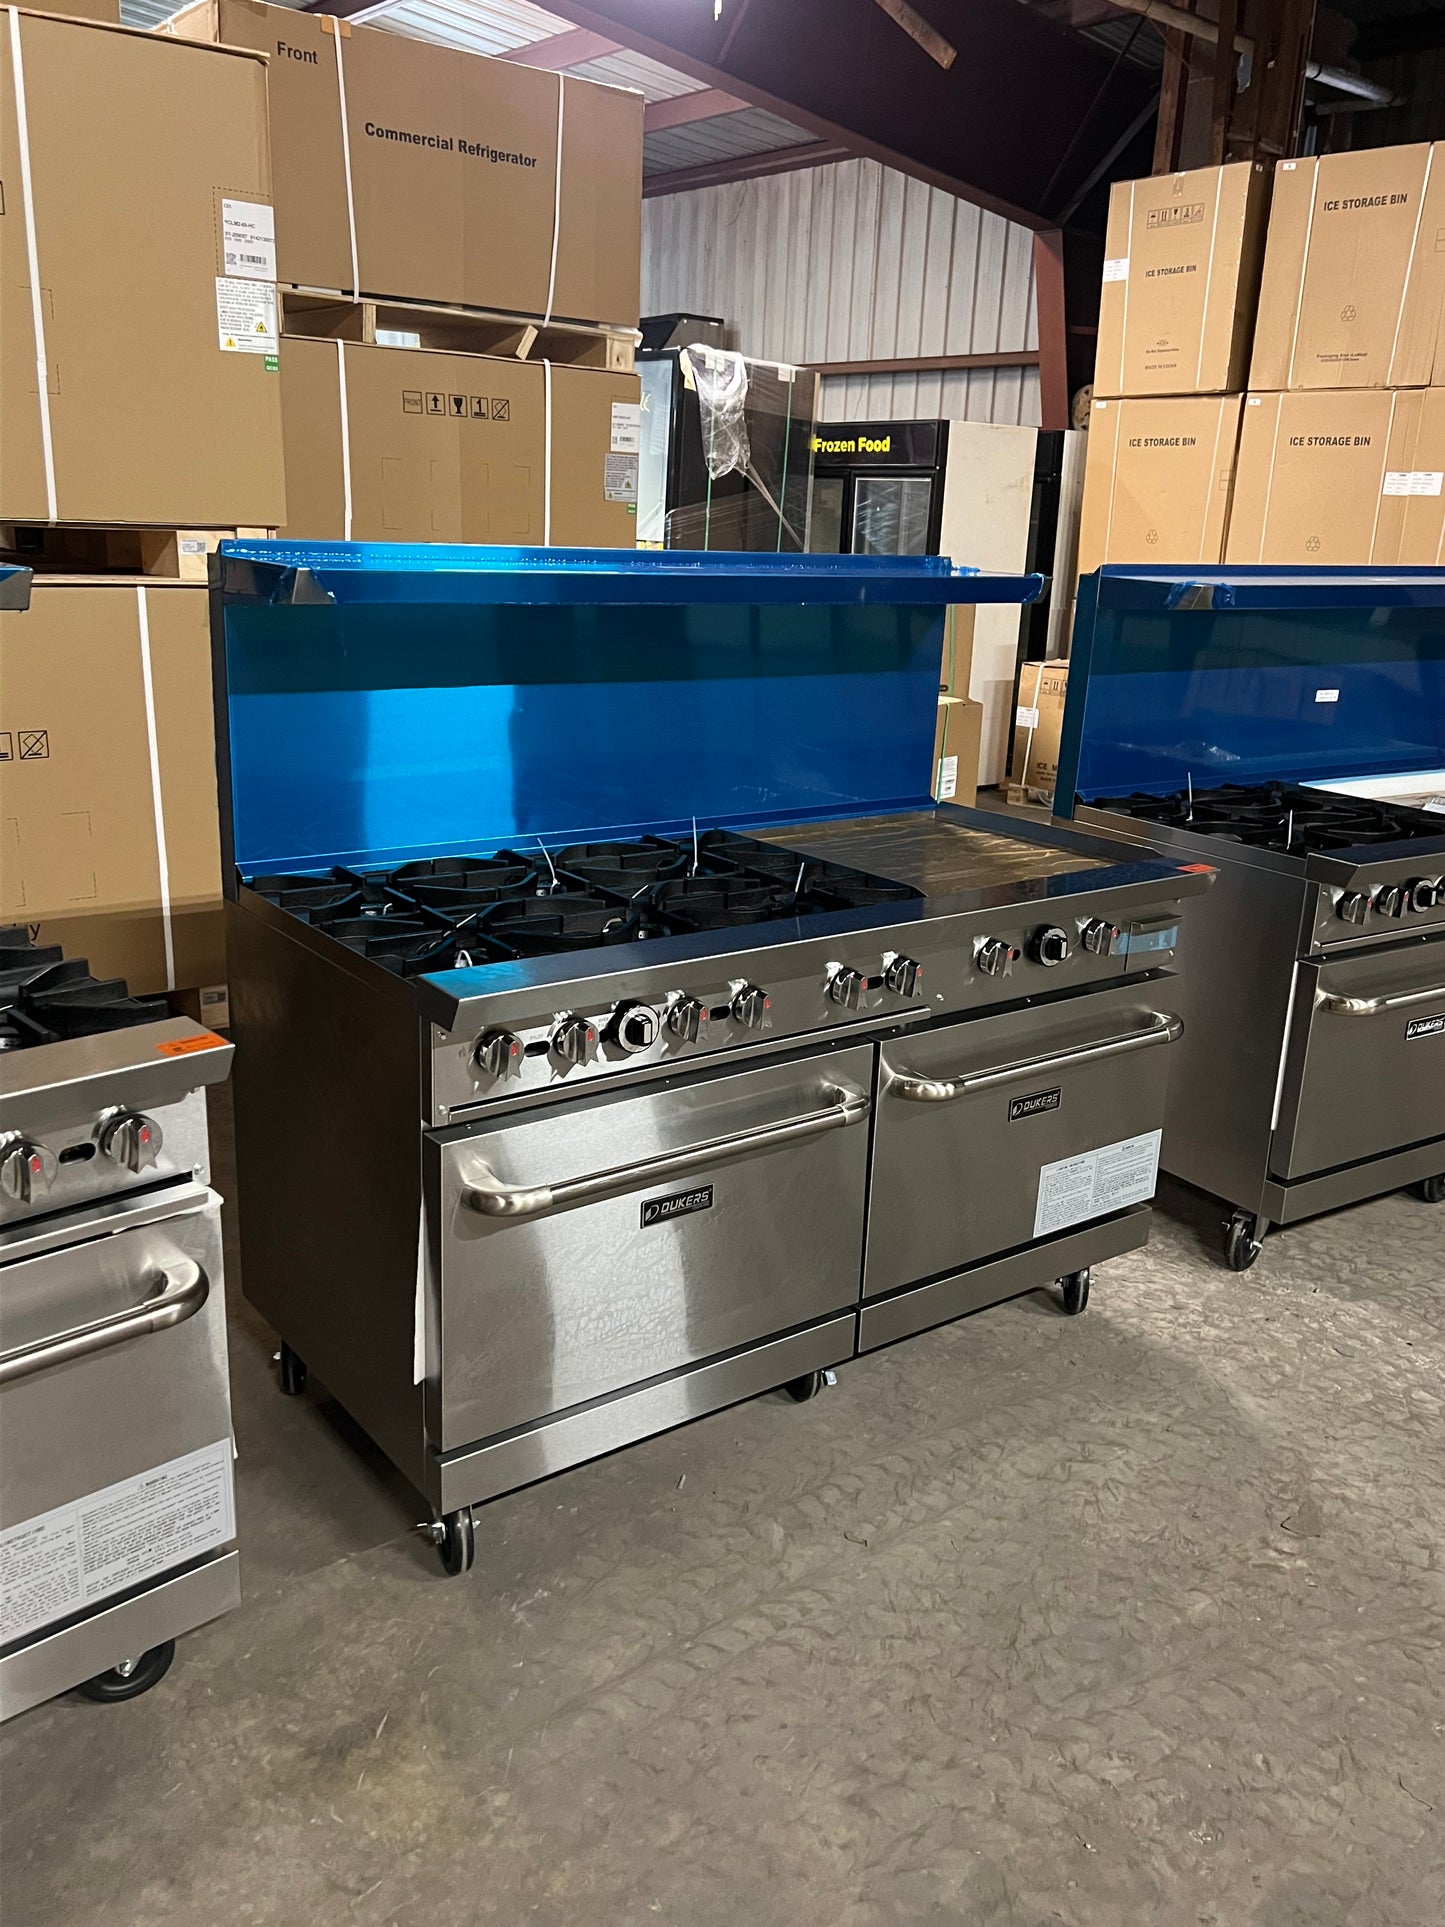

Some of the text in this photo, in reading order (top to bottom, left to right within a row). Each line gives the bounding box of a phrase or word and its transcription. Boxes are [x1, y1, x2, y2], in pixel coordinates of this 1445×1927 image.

[277, 40, 318, 64] Front
[365, 122, 537, 168] Commercial Refrigerator
[1323, 193, 1408, 211] ICE STORAGE BIN
[1145, 264, 1197, 277] ICE STORAGE BIN
[814, 435, 890, 452] Frozen Food
[1129, 437, 1196, 447] ICE STORAGE BIN
[1289, 436, 1371, 446] ICE STORAGE BIN
[1036, 762, 1048, 770] ICE
[1023, 1093, 1059, 1111] DUKERS
[660, 1190, 710, 1214] DUKERS
